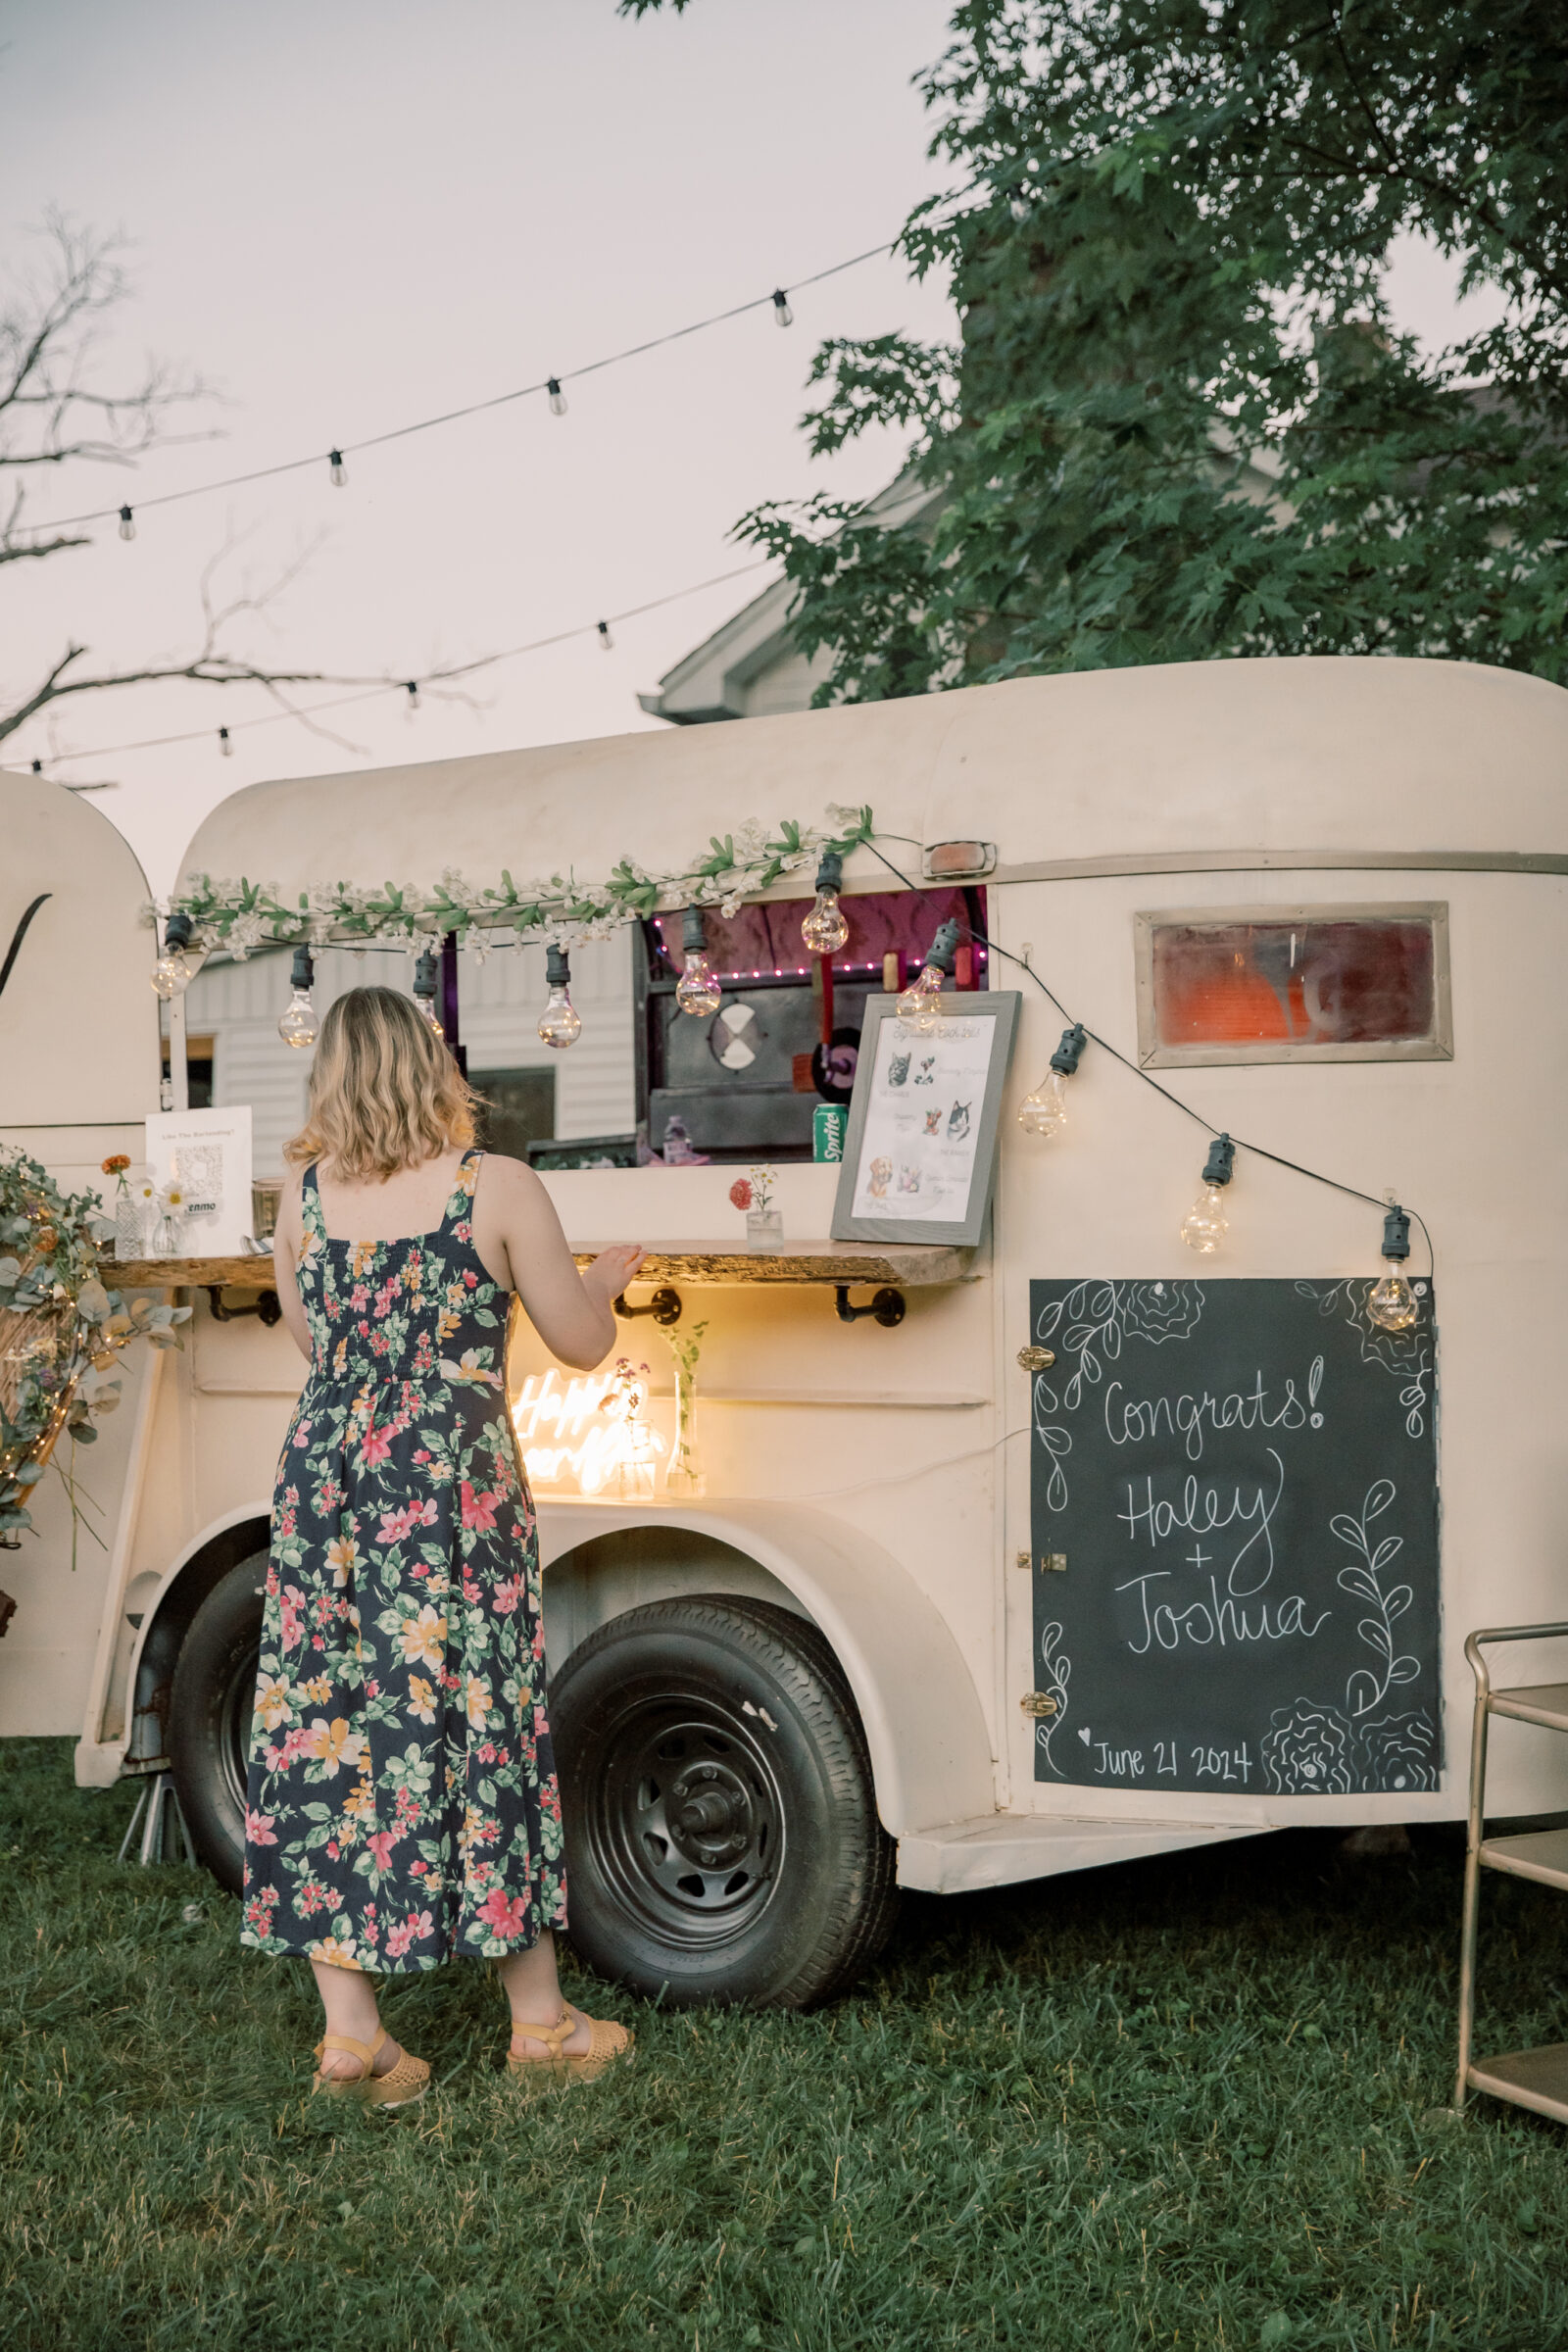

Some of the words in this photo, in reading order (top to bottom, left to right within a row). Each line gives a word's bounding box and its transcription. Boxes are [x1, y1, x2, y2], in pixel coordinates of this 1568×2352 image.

[823, 1112, 843, 1162] Sprite
[186, 1202, 217, 1212] enmo
[1105, 1356, 1324, 1460] Congrats!
[1117, 1448, 1284, 1596] Haley
[1115, 1571, 1333, 1653] Joshua
[1094, 1741, 1146, 1779] June
[1152, 1740, 1177, 1777] 21
[1190, 1740, 1253, 1784] 2024
